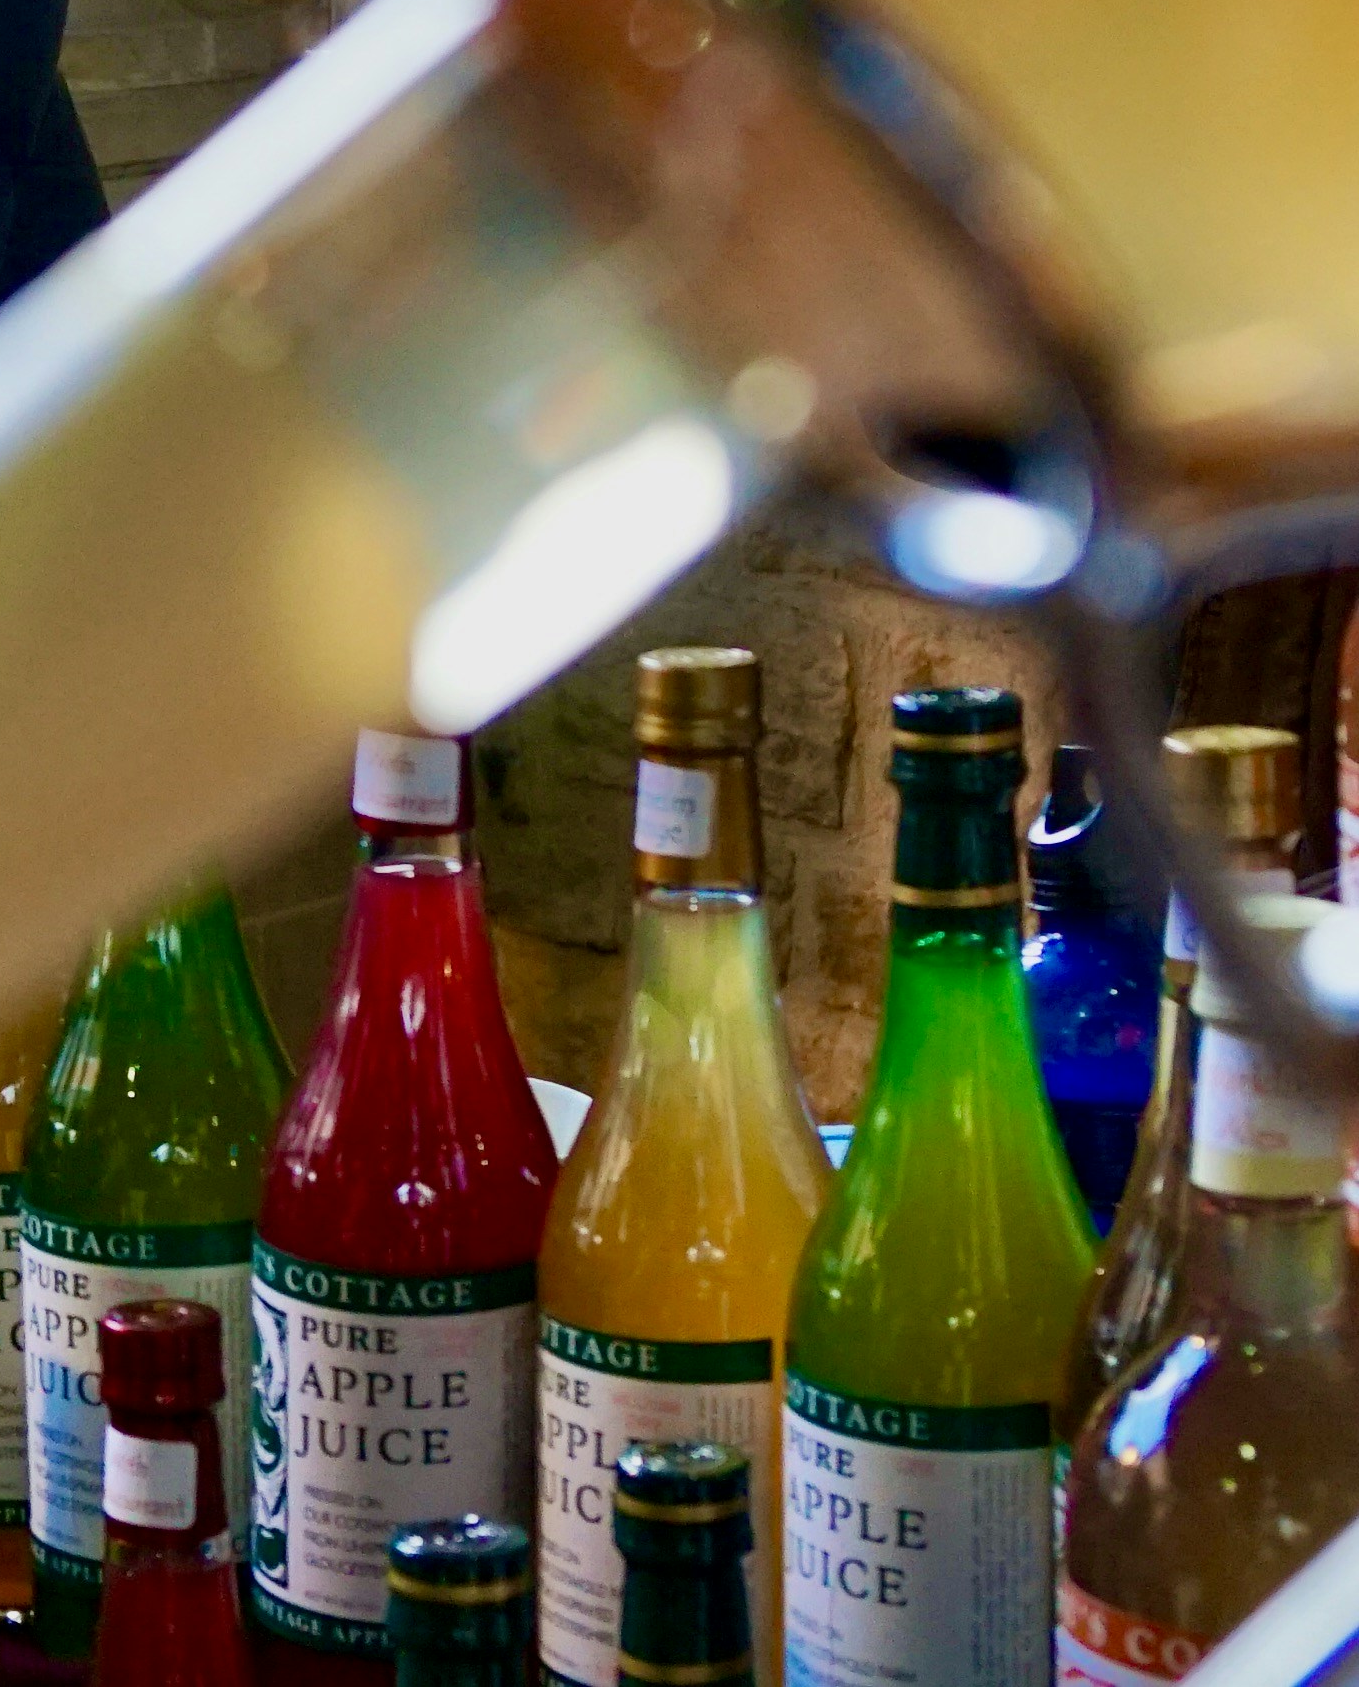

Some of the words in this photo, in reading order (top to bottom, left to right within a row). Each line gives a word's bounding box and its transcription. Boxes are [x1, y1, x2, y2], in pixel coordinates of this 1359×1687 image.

[27, 1259, 90, 1300] PURE
[285, 1264, 473, 1309] COTTAGE
[30, 1303, 99, 1352] APP
[301, 1315, 398, 1355] PURE
[547, 1319, 659, 1373] TTAGE
[28, 1352, 102, 1406] JUIC
[299, 1361, 470, 1410] APPLE
[788, 1377, 930, 1441] OTTAGE
[294, 1414, 452, 1466] JUICE
[546, 1413, 616, 1470] PPL
[793, 1535, 908, 1607] UICE
